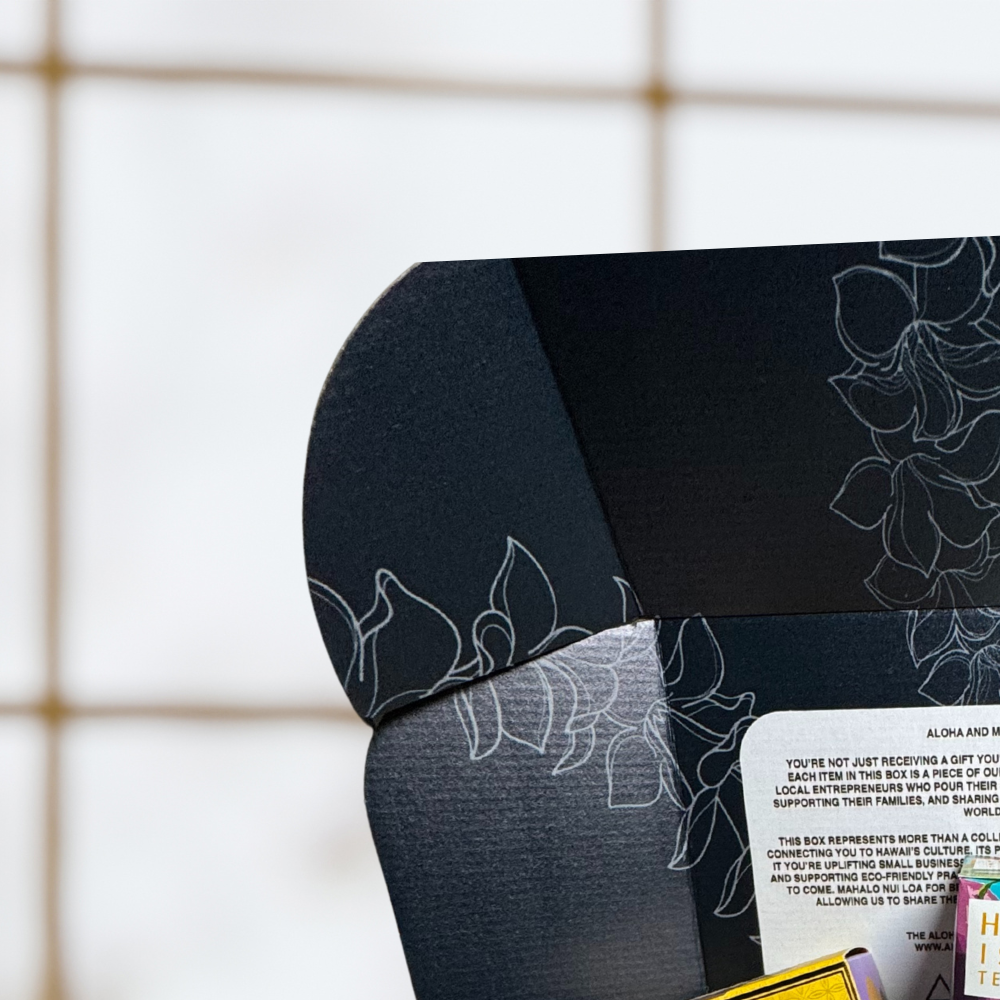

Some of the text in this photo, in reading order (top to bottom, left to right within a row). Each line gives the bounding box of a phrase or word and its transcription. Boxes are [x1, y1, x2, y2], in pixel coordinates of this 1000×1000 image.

[927, 728, 963, 738] ALOHA
[966, 727, 989, 737] AND
[787, 758, 825, 768] YOU'RE
[829, 758, 849, 768] NOT
[852, 757, 878, 767] JUST
[882, 756, 938, 766] RECEIVING
[941, 756, 948, 764] A
[951, 755, 974, 764] GIFT
[788, 772, 816, 781] EACH
[819, 771, 843, 781] ITEM
[846, 771, 856, 780] IN
[859, 770, 882, 780] THIS
[886, 770, 907, 779] BOX
[911, 769, 920, 779] IS
[923, 769, 929, 778] A
[933, 769, 963, 778] PIECE
[967, 768, 980, 777] OF
[776, 785, 810, 795] LOCAL
[813, 783, 903, 794] ENTREPRENEURS
[906, 782, 930, 792] WHO
[934, 782, 963, 791] POUR
[967, 780, 997, 791] THEIR
[773, 798, 839, 808] SUPPORTING
[842, 797, 872, 806] THEIR
[876, 796, 924, 806] FAMILIES,
[928, 795, 949, 804] AND
[952, 794, 998, 804] SHARING
[779, 837, 801, 846] THIS
[804, 836, 825, 846] BOX
[829, 835, 895, 845] REPRESENTS
[899, 834, 928, 844] MORE
[931, 833, 958, 843] THAN
[961, 833, 968, 842] A
[767, 849, 833, 859] CONNECTING
[835, 849, 857, 858] YOU
[860, 848, 873, 857] TO
[876, 847, 920, 857] HAWAII'S
[976, 846, 991, 855] ITS
[773, 862, 781, 871] IT
[784, 861, 821, 870] YOU'RE
[825, 861, 876, 870] UPLIFTING
[879, 860, 913, 868] SMALL
[771, 874, 791, 883] AND
[794, 873, 858, 882] SUPPORTING
[862, 872, 933, 881] ECO-FRIENDLY
[787, 886, 800, 894] TO
[803, 886, 834, 894] COME.
[838, 885, 880, 894] MAHALO
[883, 884, 899, 893] NUI
[902, 884, 922, 893] LOA
[926, 884, 945, 892] FOR
[816, 897, 868, 906] ALLOWING
[871, 897, 884, 905] US
[887, 897, 900, 905] TO
[903, 896, 937, 904] SHARE
